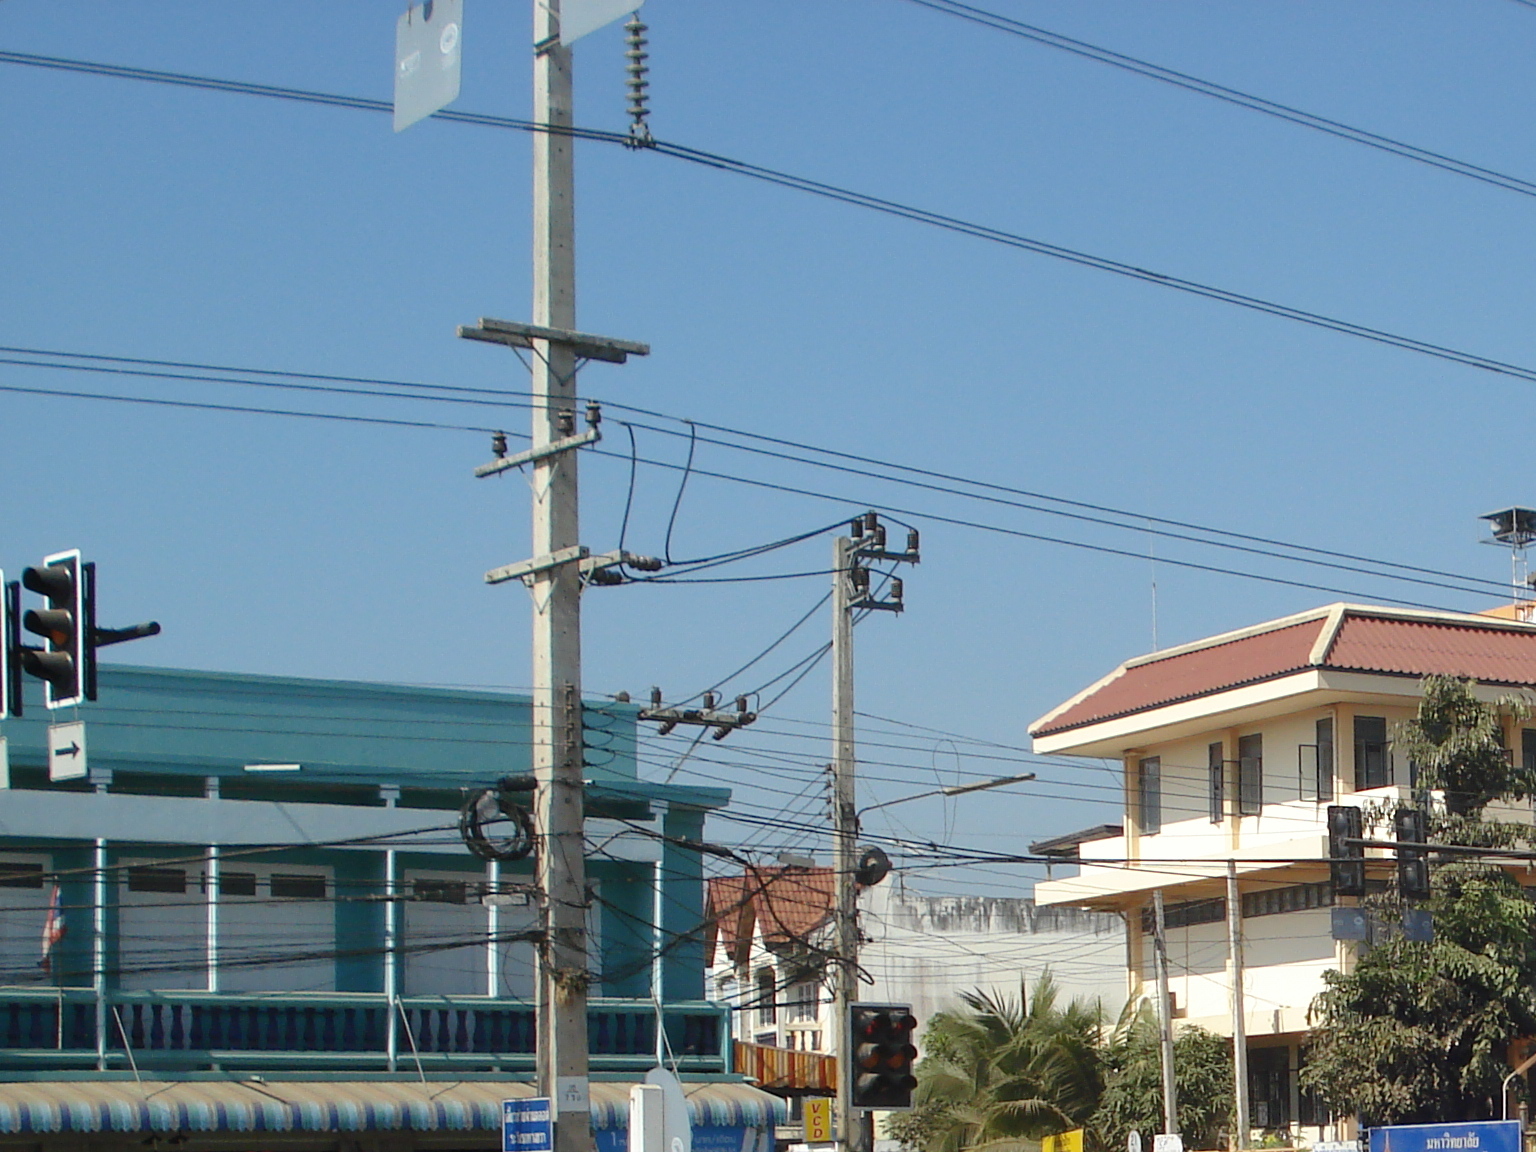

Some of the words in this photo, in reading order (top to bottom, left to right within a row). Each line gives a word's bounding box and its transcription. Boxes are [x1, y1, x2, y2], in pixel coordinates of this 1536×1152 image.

[811, 1103, 823, 1139] VCD
[1426, 1132, 1480, 1149] มหาวิทยาลัย
